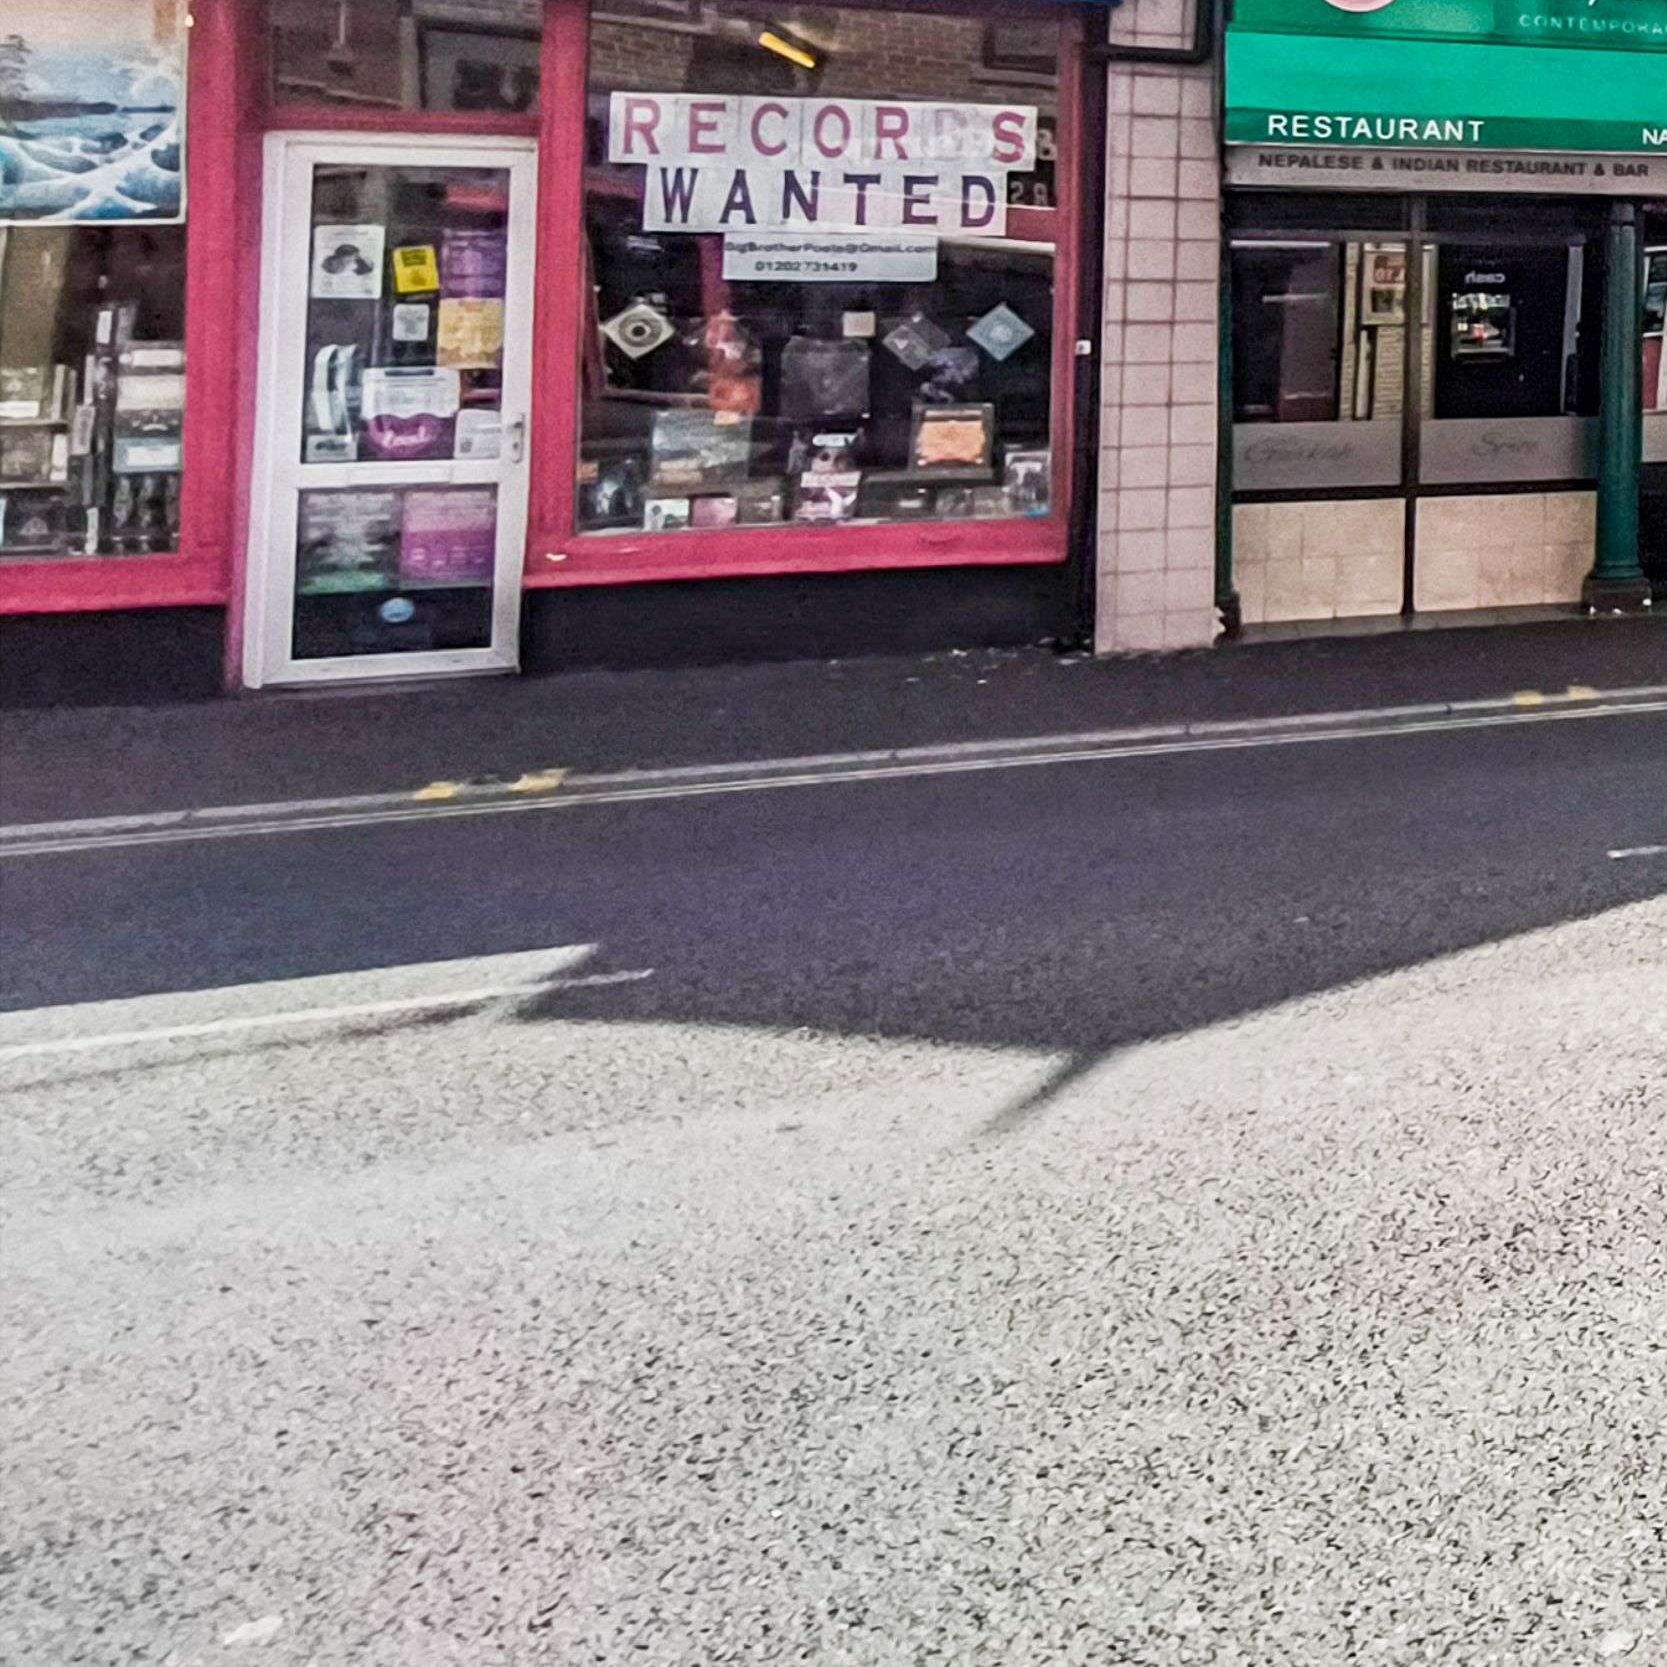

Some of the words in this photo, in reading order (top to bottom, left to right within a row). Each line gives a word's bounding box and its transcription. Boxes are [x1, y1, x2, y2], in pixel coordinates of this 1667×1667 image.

[1268, 114, 1485, 142] RESTAURANT
[1258, 153, 1363, 171] NEPALESE
[1371, 159, 1384, 171] &
[1393, 157, 1459, 173] INDIAN
[1466, 159, 1586, 177] RESTAURANT
[1594, 163, 1606, 177] &
[1613, 163, 1649, 178] BAR
[660, 167, 997, 229] WANTED
